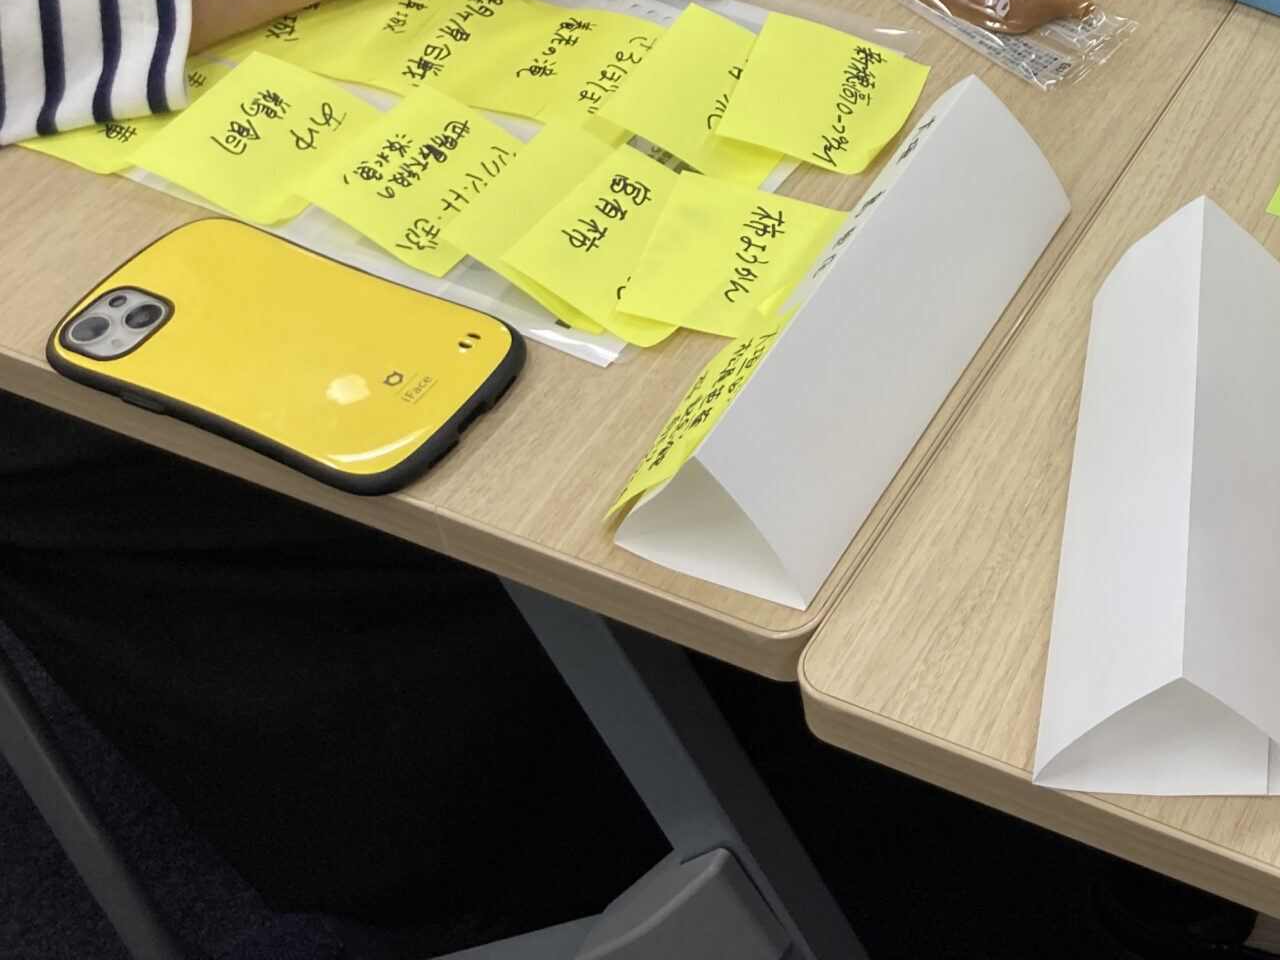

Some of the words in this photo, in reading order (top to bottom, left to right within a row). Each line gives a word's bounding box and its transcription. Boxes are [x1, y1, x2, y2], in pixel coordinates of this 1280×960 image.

[516, 16, 597, 79] 養老の滝
[211, 88, 292, 156] 鵜飼
[294, 102, 347, 151] あゆ
[561, 173, 652, 253] 富有柿
[723, 204, 785, 304] 柿ようかん
